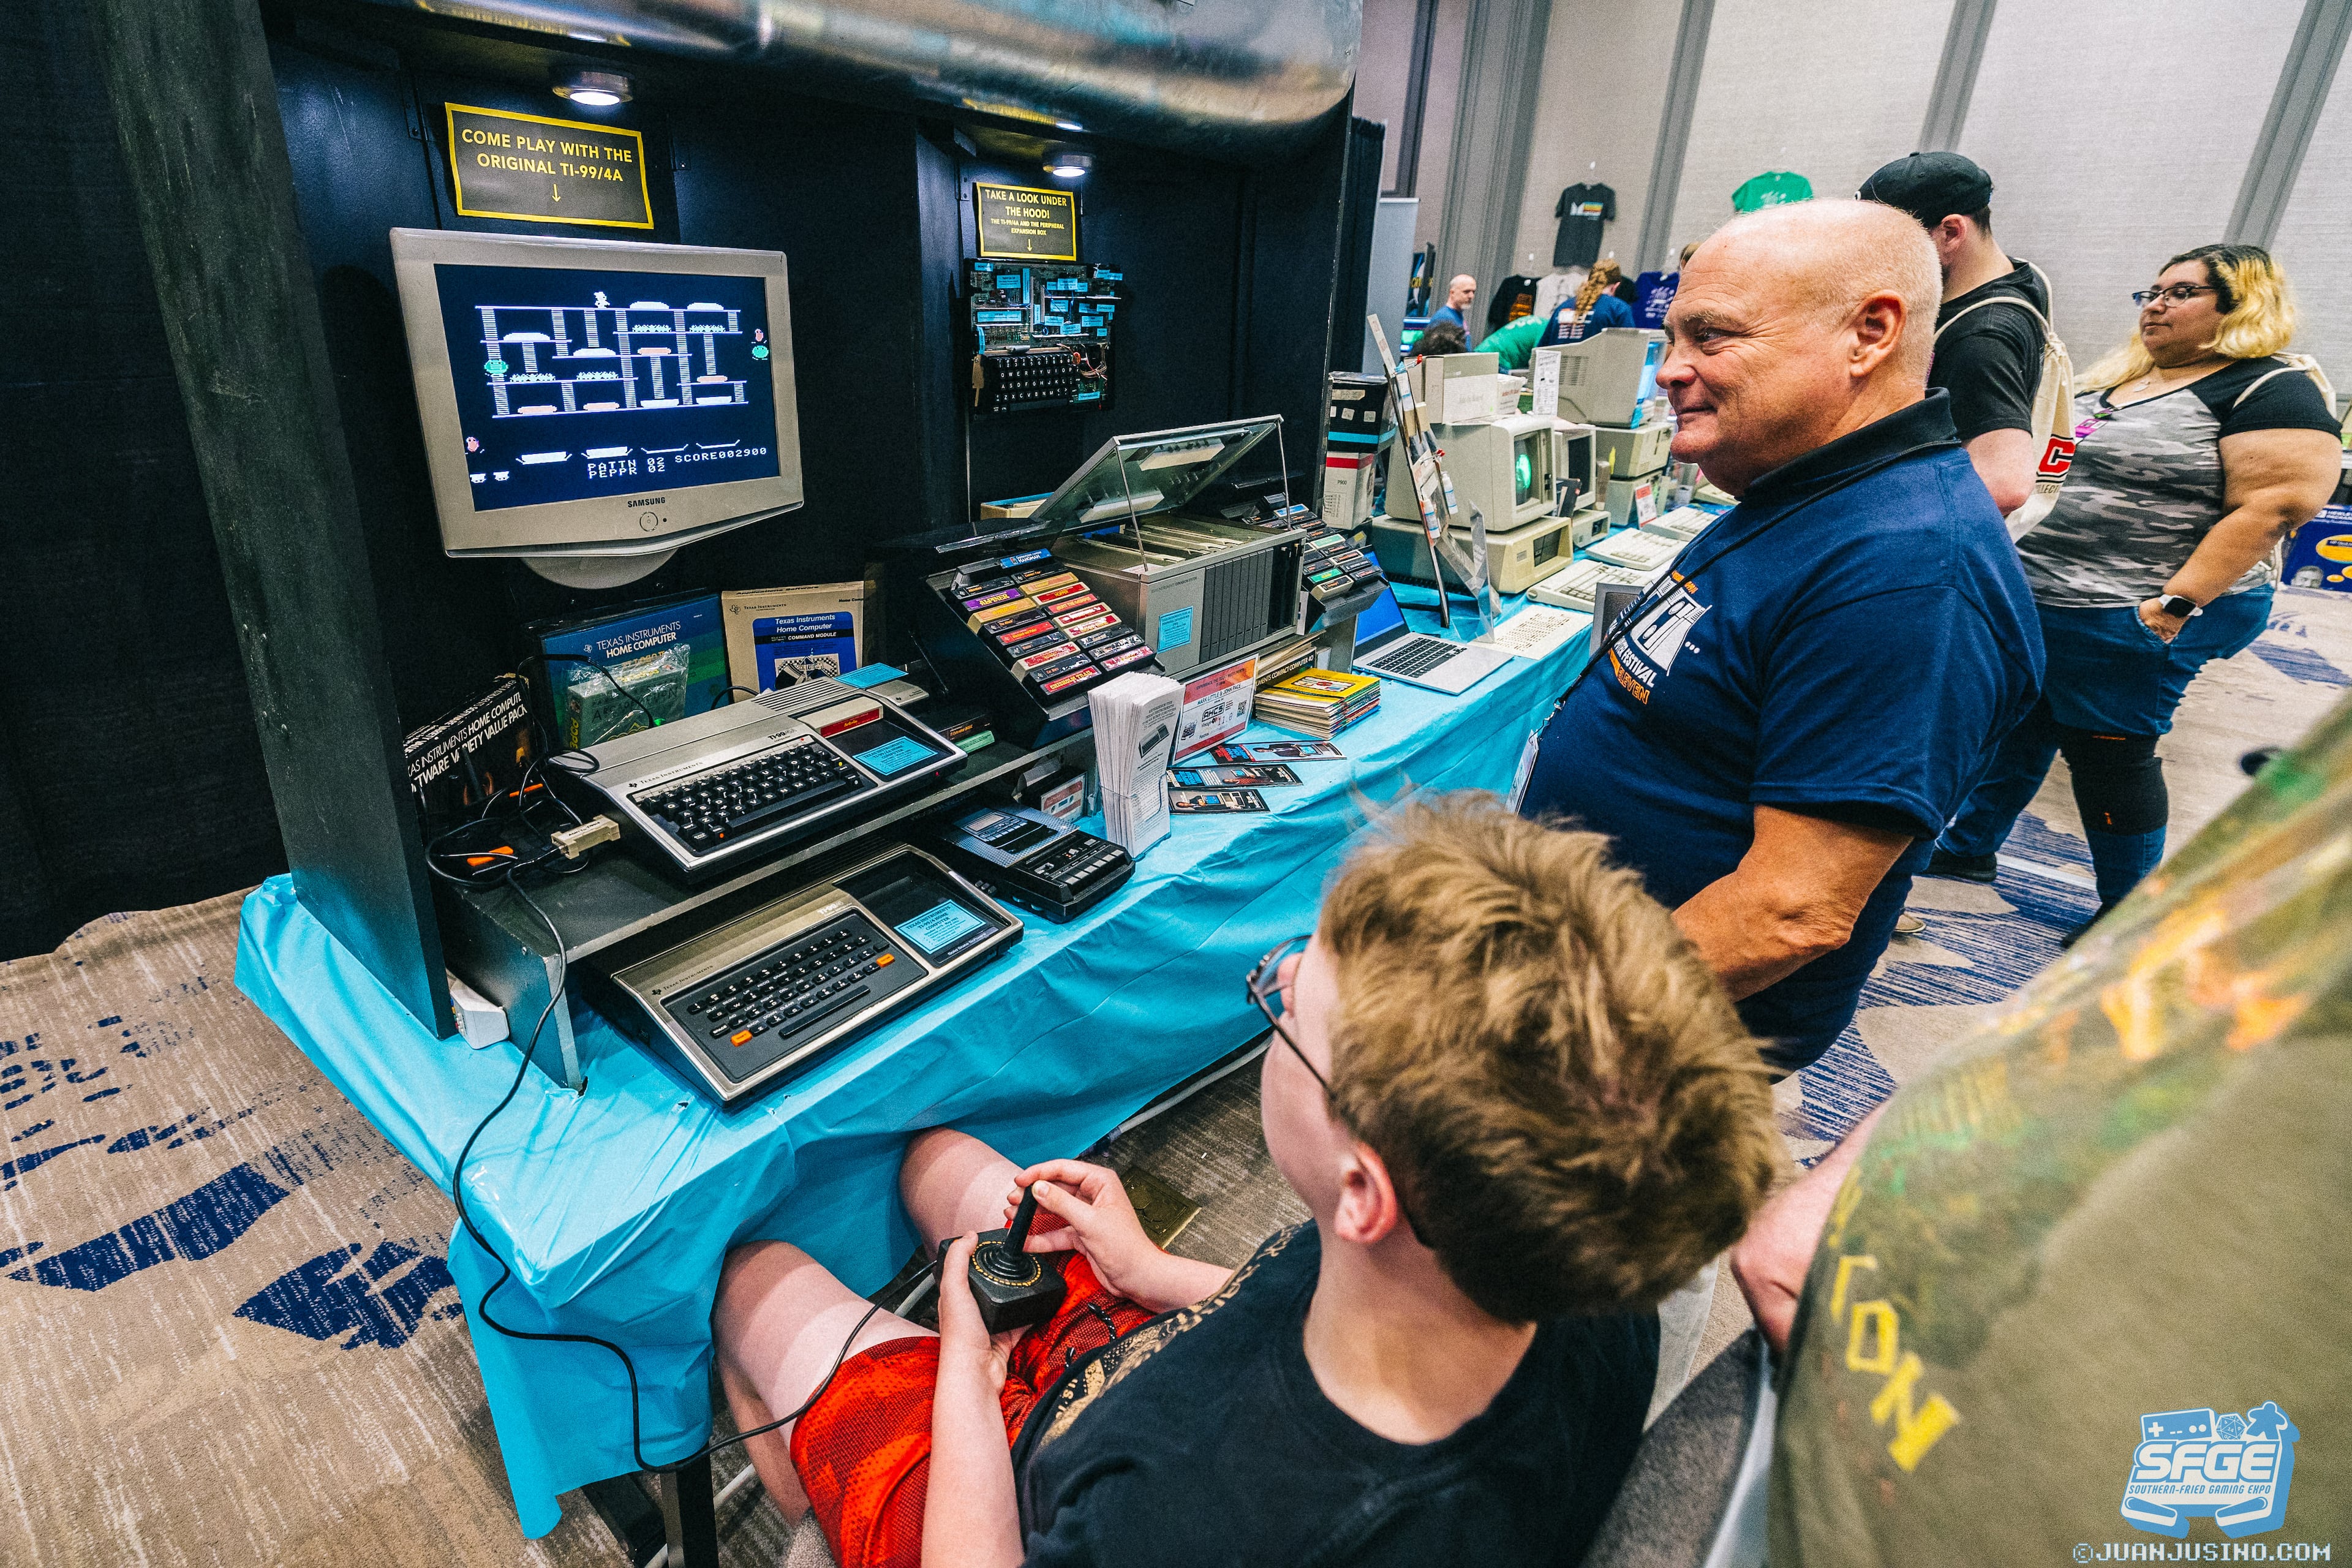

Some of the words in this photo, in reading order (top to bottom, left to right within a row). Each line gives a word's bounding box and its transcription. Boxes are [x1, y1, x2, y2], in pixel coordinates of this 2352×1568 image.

[462, 129, 511, 148] COME
[516, 135, 556, 153] PLAY
[560, 141, 600, 159] WITH
[604, 147, 633, 162] THE
[477, 153, 556, 175] ORIGINAL
[560, 162, 624, 182] TI-99/4A
[985, 189, 1006, 201] TAKE
[1008, 192, 1015, 202] A
[1017, 192, 1039, 204] LOOK
[1041, 195, 1067, 206] UNDER
[1005, 206, 1022, 217] THE
[1023, 208, 1050, 219] HOOD!
[587, 459, 636, 471] PATTN
[675, 447, 767, 462] SCORE002900
[589, 467, 638, 479] PEPPR
[627, 497, 666, 508] SAMSUNG
[1018, 554, 1041, 564] HANGMAN
[796, 614, 835, 623] Instruments
[799, 623, 832, 632] Computer
[597, 636, 624, 650] TEXAS
[625, 620, 681, 643] INSTRUMENTS
[606, 643, 632, 658] HOME
[633, 631, 677, 649] COMPUTER
[1272, 666, 1290, 679] COMPACT
[1289, 658, 1308, 671] COMPUTER
[1623, 648, 1657, 688] FESTIVAL
[1050, 676, 1077, 690] CHISHOLM
[1076, 669, 1093, 682] TRAIL
[1618, 666, 1650, 705] ELEVEN
[1207, 693, 1219, 701] LITTLE
[1203, 704, 1224, 720] AHCS
[484, 718, 508, 740] VALUE
[421, 728, 467, 768] INSTRUMENTS
[468, 712, 490, 736] HOME
[639, 775, 660, 785] TEXAS
[660, 761, 703, 779] INSTRUMENTS
[906, 920, 921, 930] TEXAS
[921, 906, 951, 924] INSTRUMENTS
[925, 916, 951, 930] COMPUTER
[934, 912, 949, 922] HOME
[968, 932, 987, 944] Software
[663, 982, 679, 990] TEXAS
[679, 965, 713, 982] INSTRUMENTS
